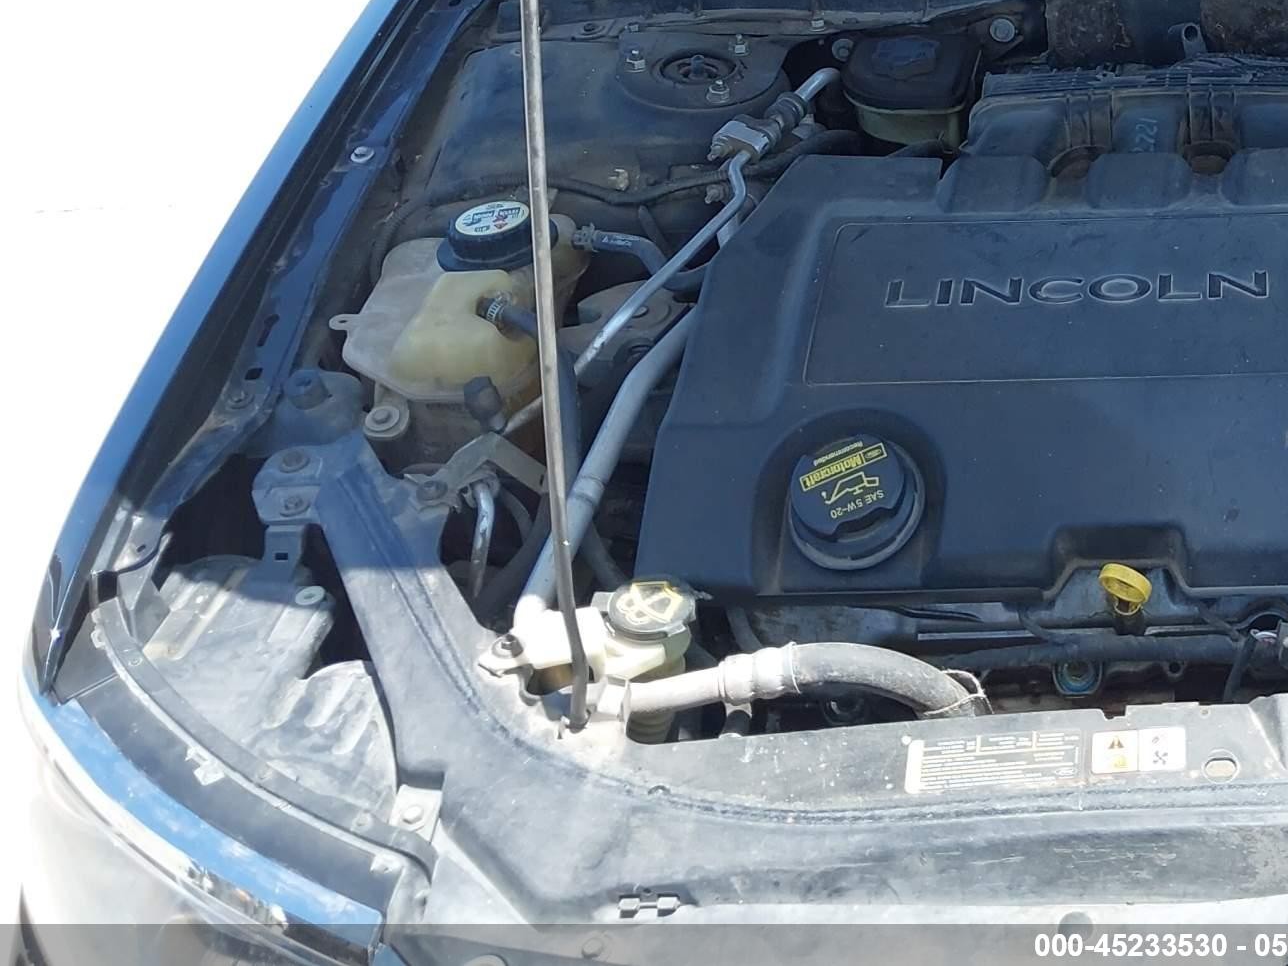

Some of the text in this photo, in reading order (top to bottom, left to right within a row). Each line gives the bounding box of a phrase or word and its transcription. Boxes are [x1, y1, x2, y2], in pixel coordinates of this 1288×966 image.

[884, 269, 1271, 308] LINCOLN
[813, 440, 863, 467] Recommended
[803, 454, 865, 488] Motorcraft
[830, 489, 885, 519] SAE 5W-20
